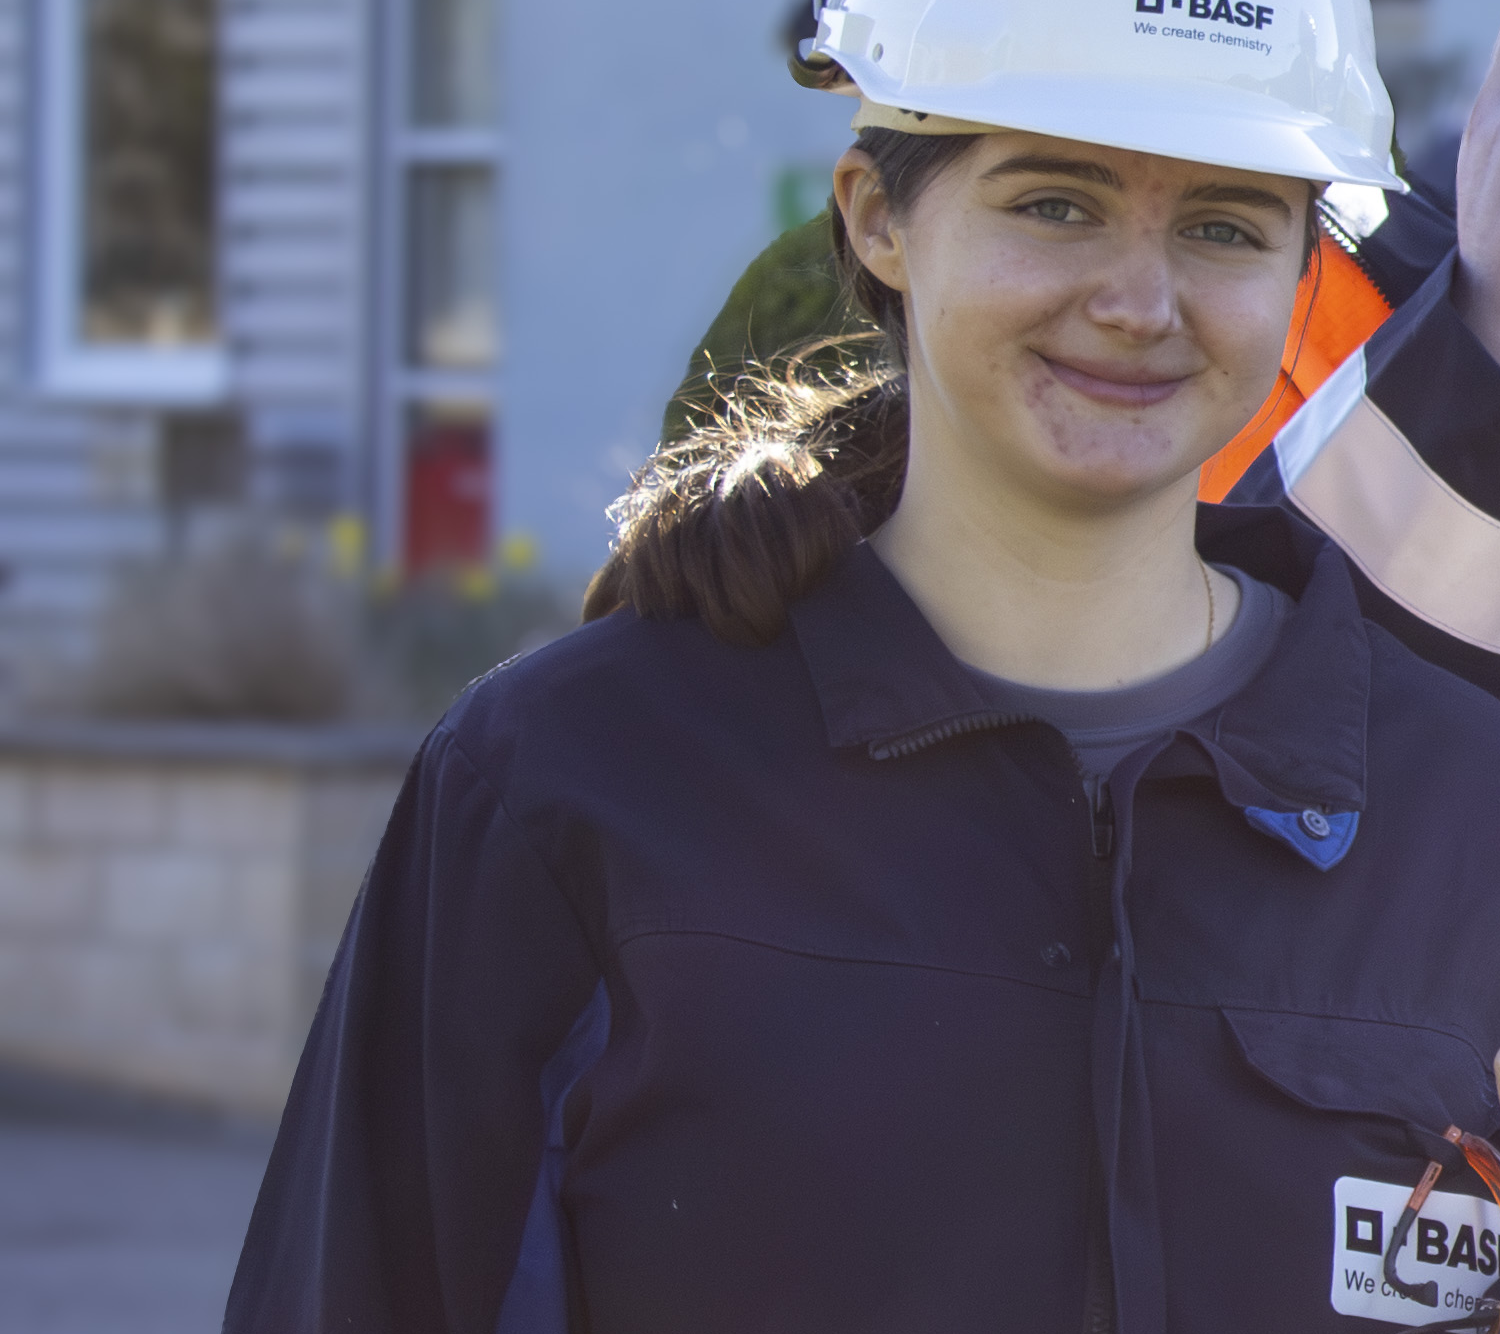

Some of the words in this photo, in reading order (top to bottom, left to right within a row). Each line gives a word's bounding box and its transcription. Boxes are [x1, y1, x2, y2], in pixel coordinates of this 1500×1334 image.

[1134, 21, 1158, 35] We
[1162, 24, 1206, 41] create
[1209, 31, 1273, 56] chemistry
[1345, 1268, 1376, 1293] We
